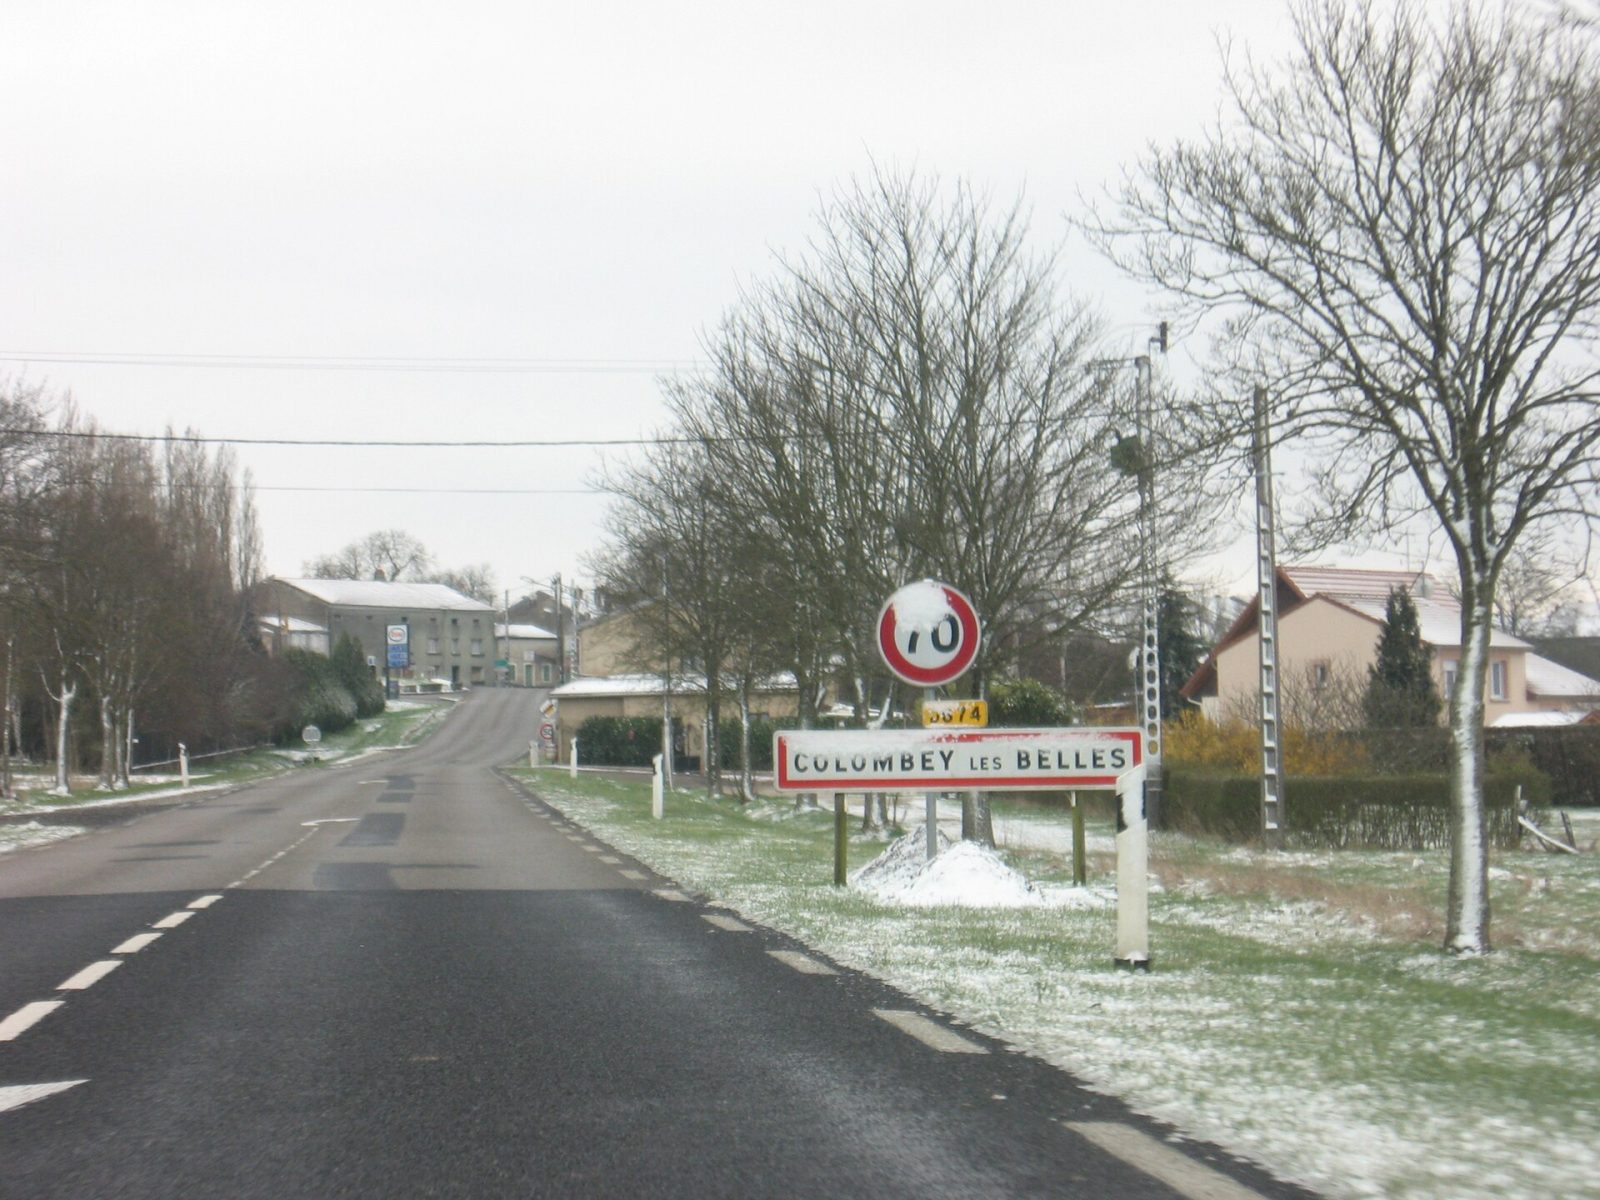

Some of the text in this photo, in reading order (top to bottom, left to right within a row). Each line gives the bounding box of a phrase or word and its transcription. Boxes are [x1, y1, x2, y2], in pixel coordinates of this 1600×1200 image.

[794, 748, 1126, 773] COLOMBEY LES BELLES
